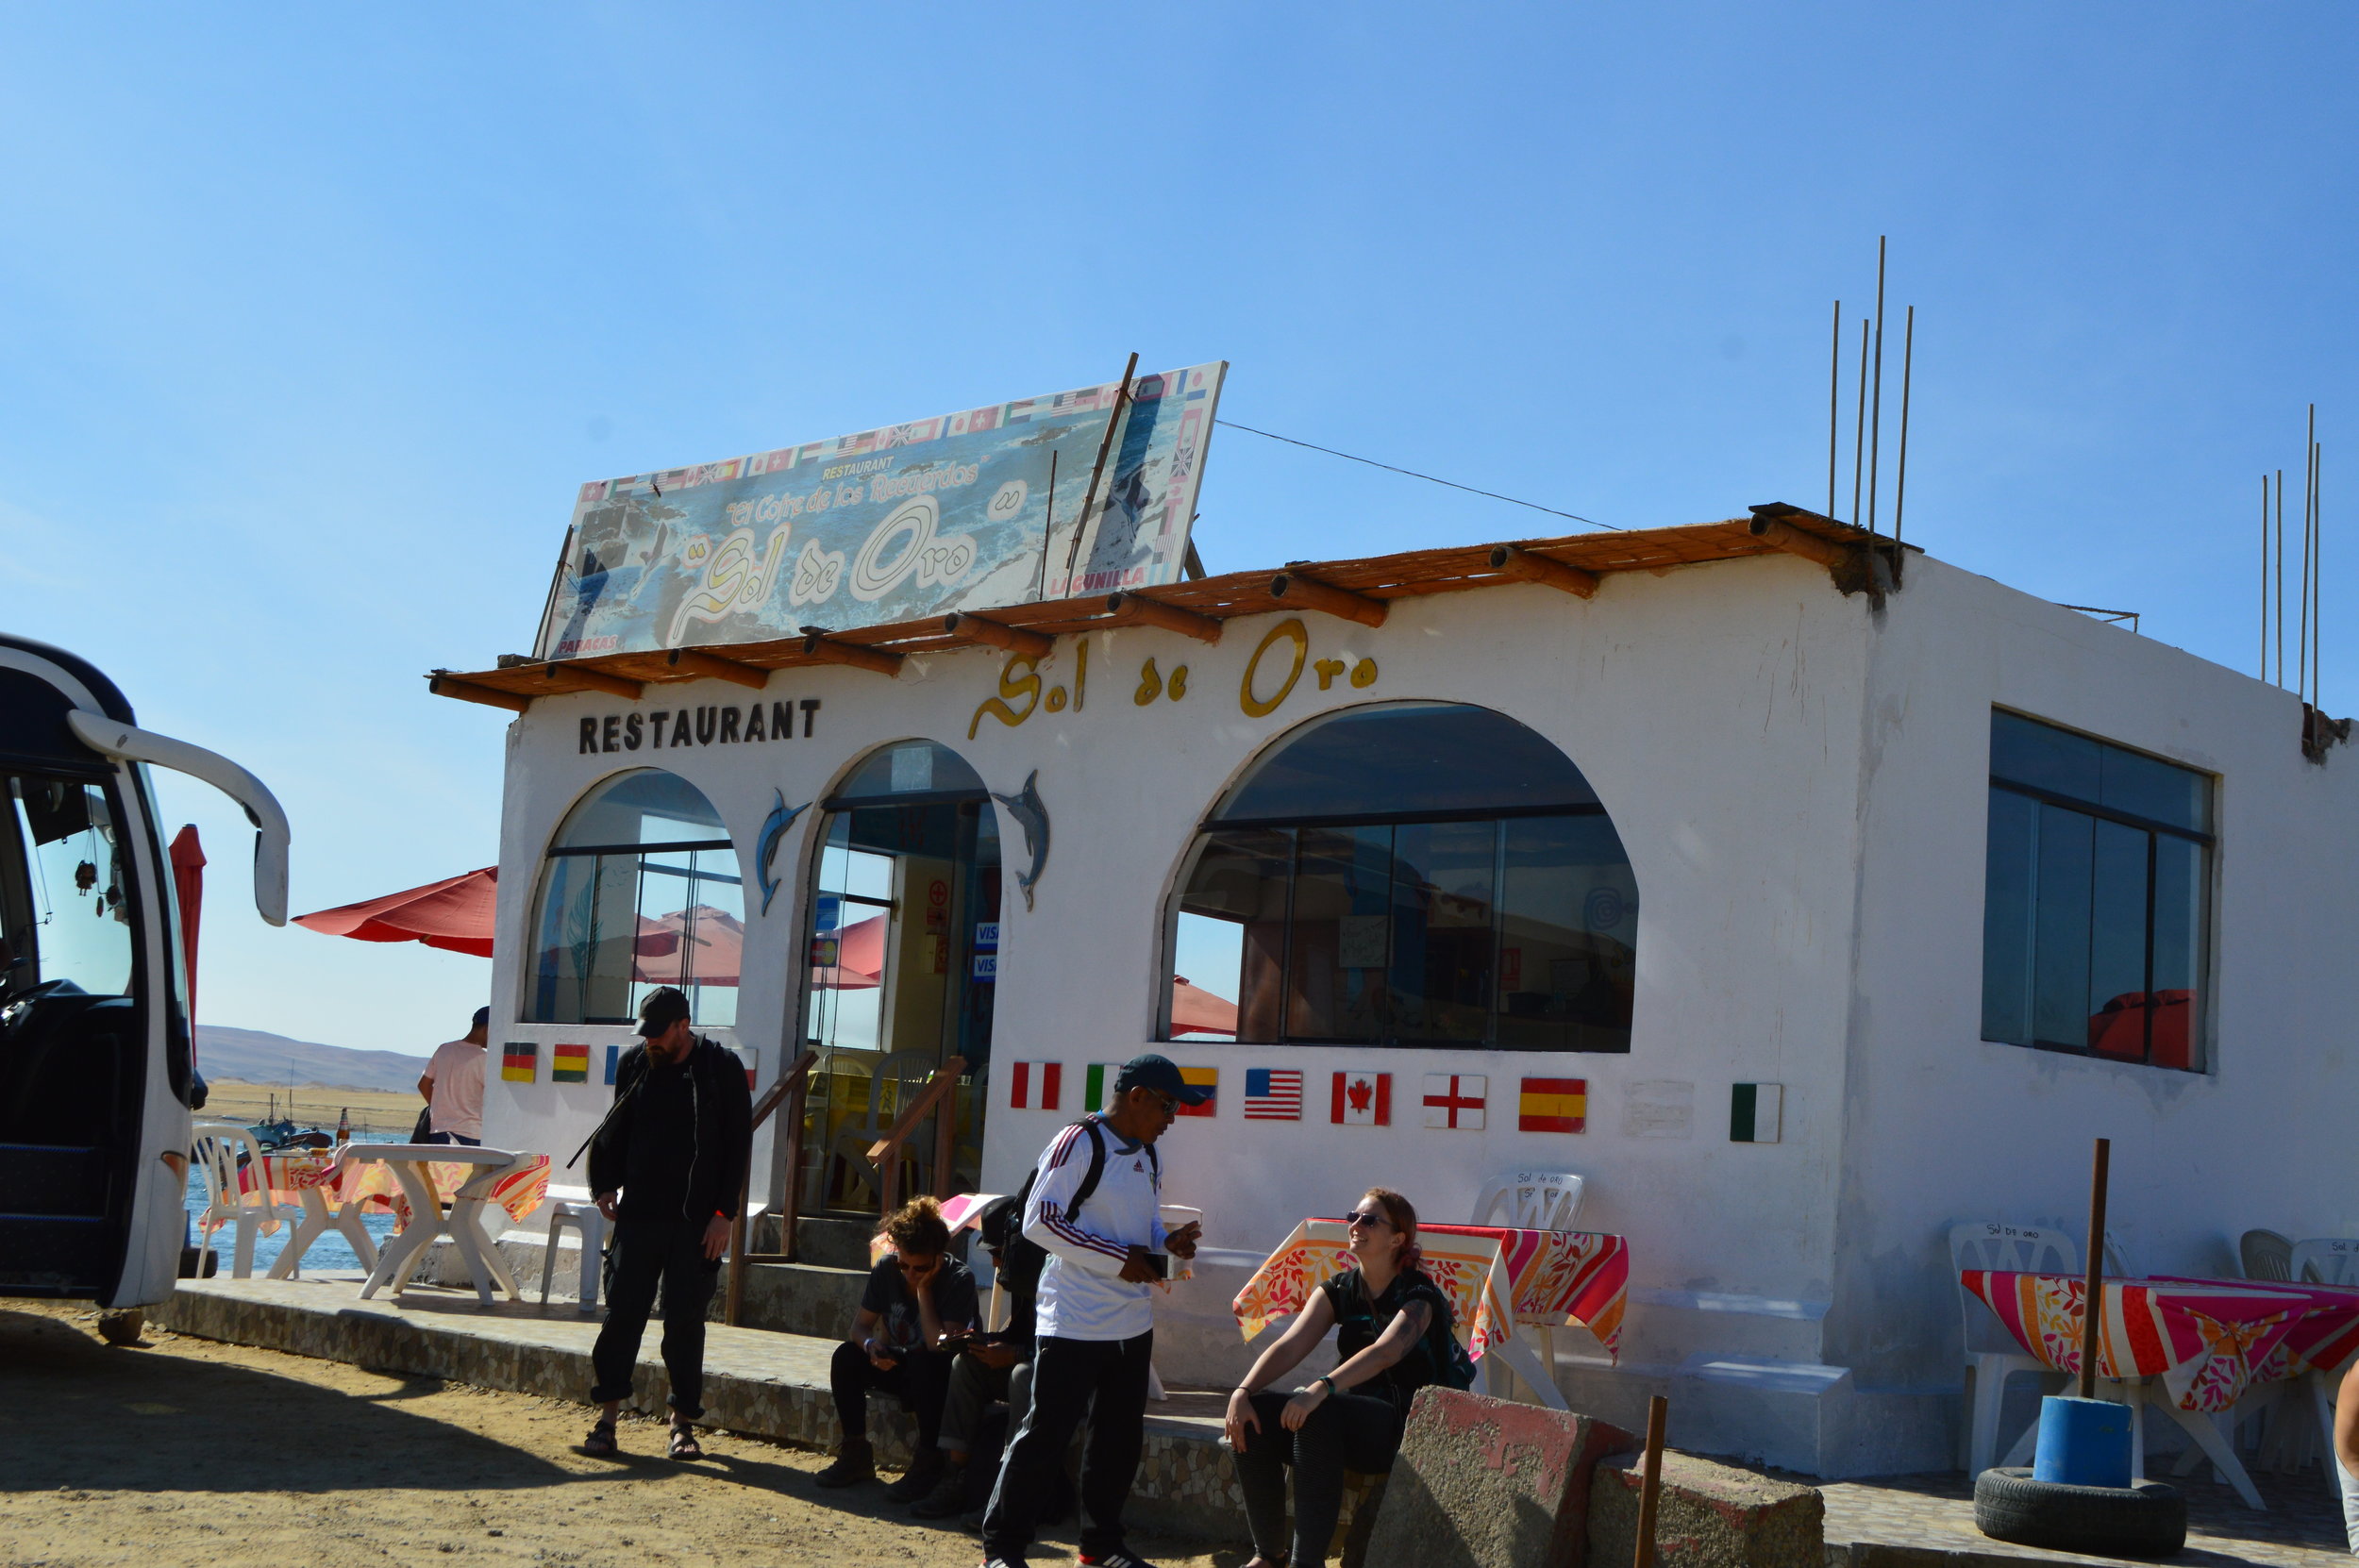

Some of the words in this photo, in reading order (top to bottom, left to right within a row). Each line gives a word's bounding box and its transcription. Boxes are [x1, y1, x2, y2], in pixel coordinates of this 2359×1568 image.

[821, 455, 895, 481] RESTAURANT
[756, 492, 805, 525] Cofre
[806, 486, 832, 515] de
[833, 482, 864, 509] los
[792, 542, 843, 603] de
[558, 634, 618, 654] PARACAS
[967, 638, 1090, 741] Sol
[1133, 658, 1189, 707] de
[1239, 618, 1379, 719] Oro
[578, 698, 822, 755] RESTAURANT
[979, 926, 999, 940] VIS
[977, 959, 997, 973] VIS
[1517, 1173, 1532, 1183] Sol
[1986, 1224, 2001, 1235] Sol
[2023, 1230, 2039, 1239] ORO
[2332, 1241, 2347, 1251] Sol
